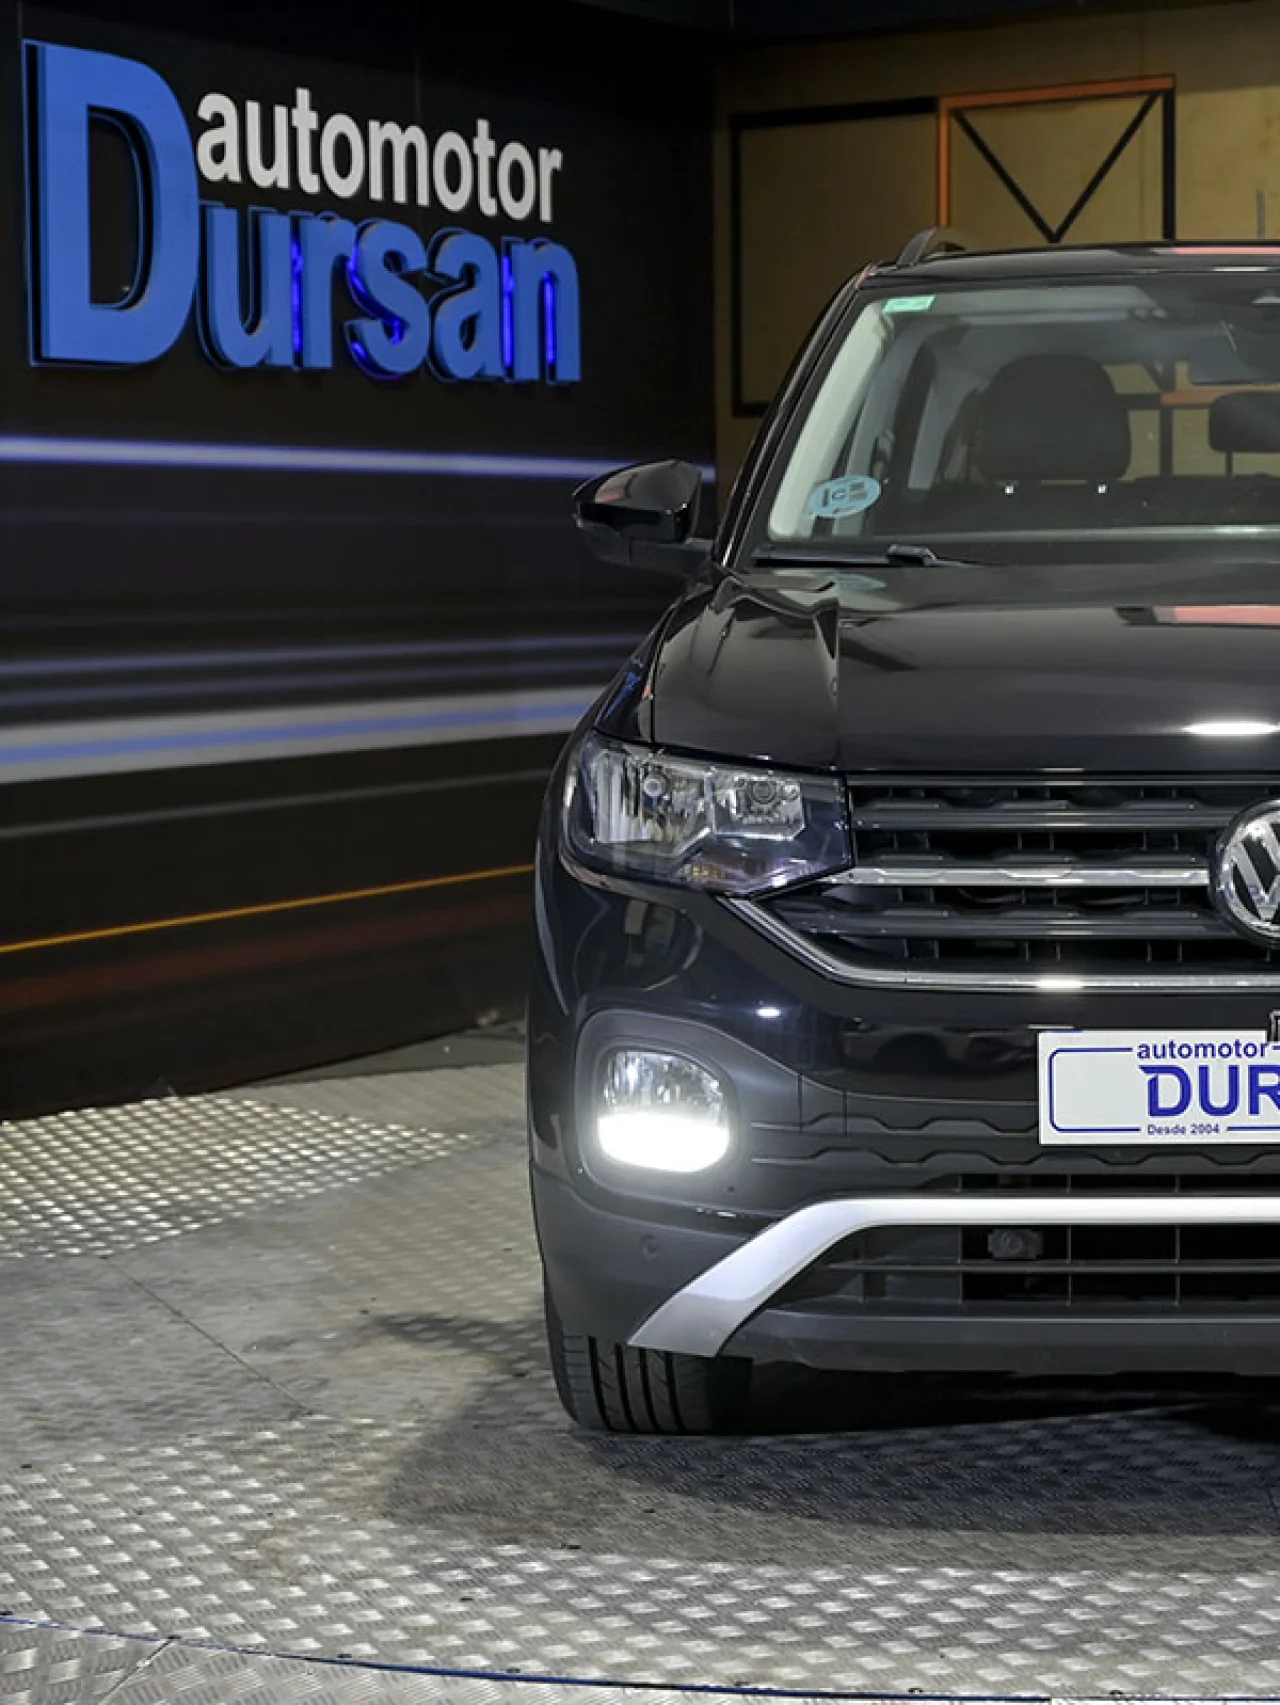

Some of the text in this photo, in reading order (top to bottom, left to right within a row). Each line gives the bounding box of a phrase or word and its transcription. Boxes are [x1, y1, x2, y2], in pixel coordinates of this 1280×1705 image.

[196, 88, 562, 222] automotor
[22, 39, 581, 384] Dursan
[1137, 1039, 1268, 1059] automotor
[1147, 1123, 1220, 1135] Desde 2004
